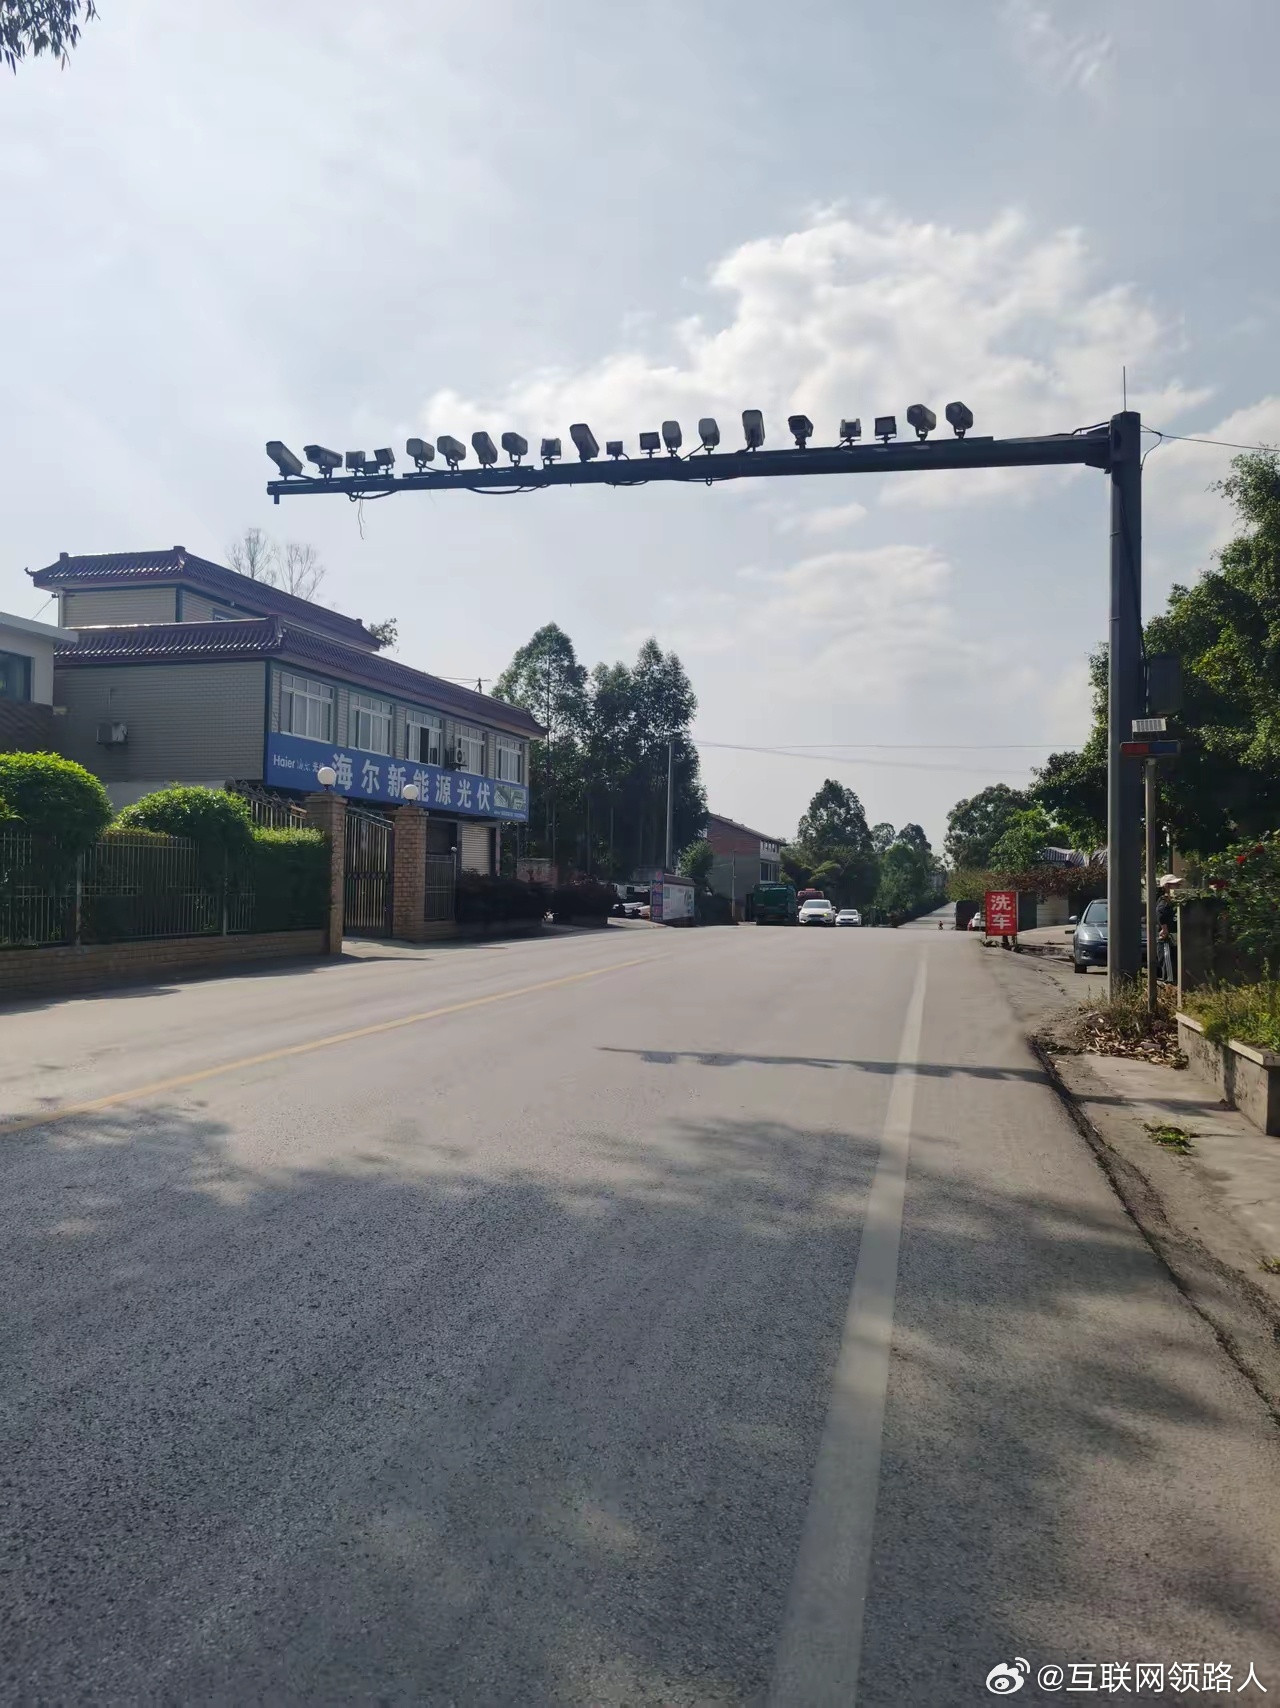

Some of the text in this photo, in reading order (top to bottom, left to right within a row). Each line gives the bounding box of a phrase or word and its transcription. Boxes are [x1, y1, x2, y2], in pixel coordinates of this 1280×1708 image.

[273, 754, 296, 769] Haier
[331, 753, 491, 812] 海尔新能源光伏
[990, 894, 1012, 930] 洗车
